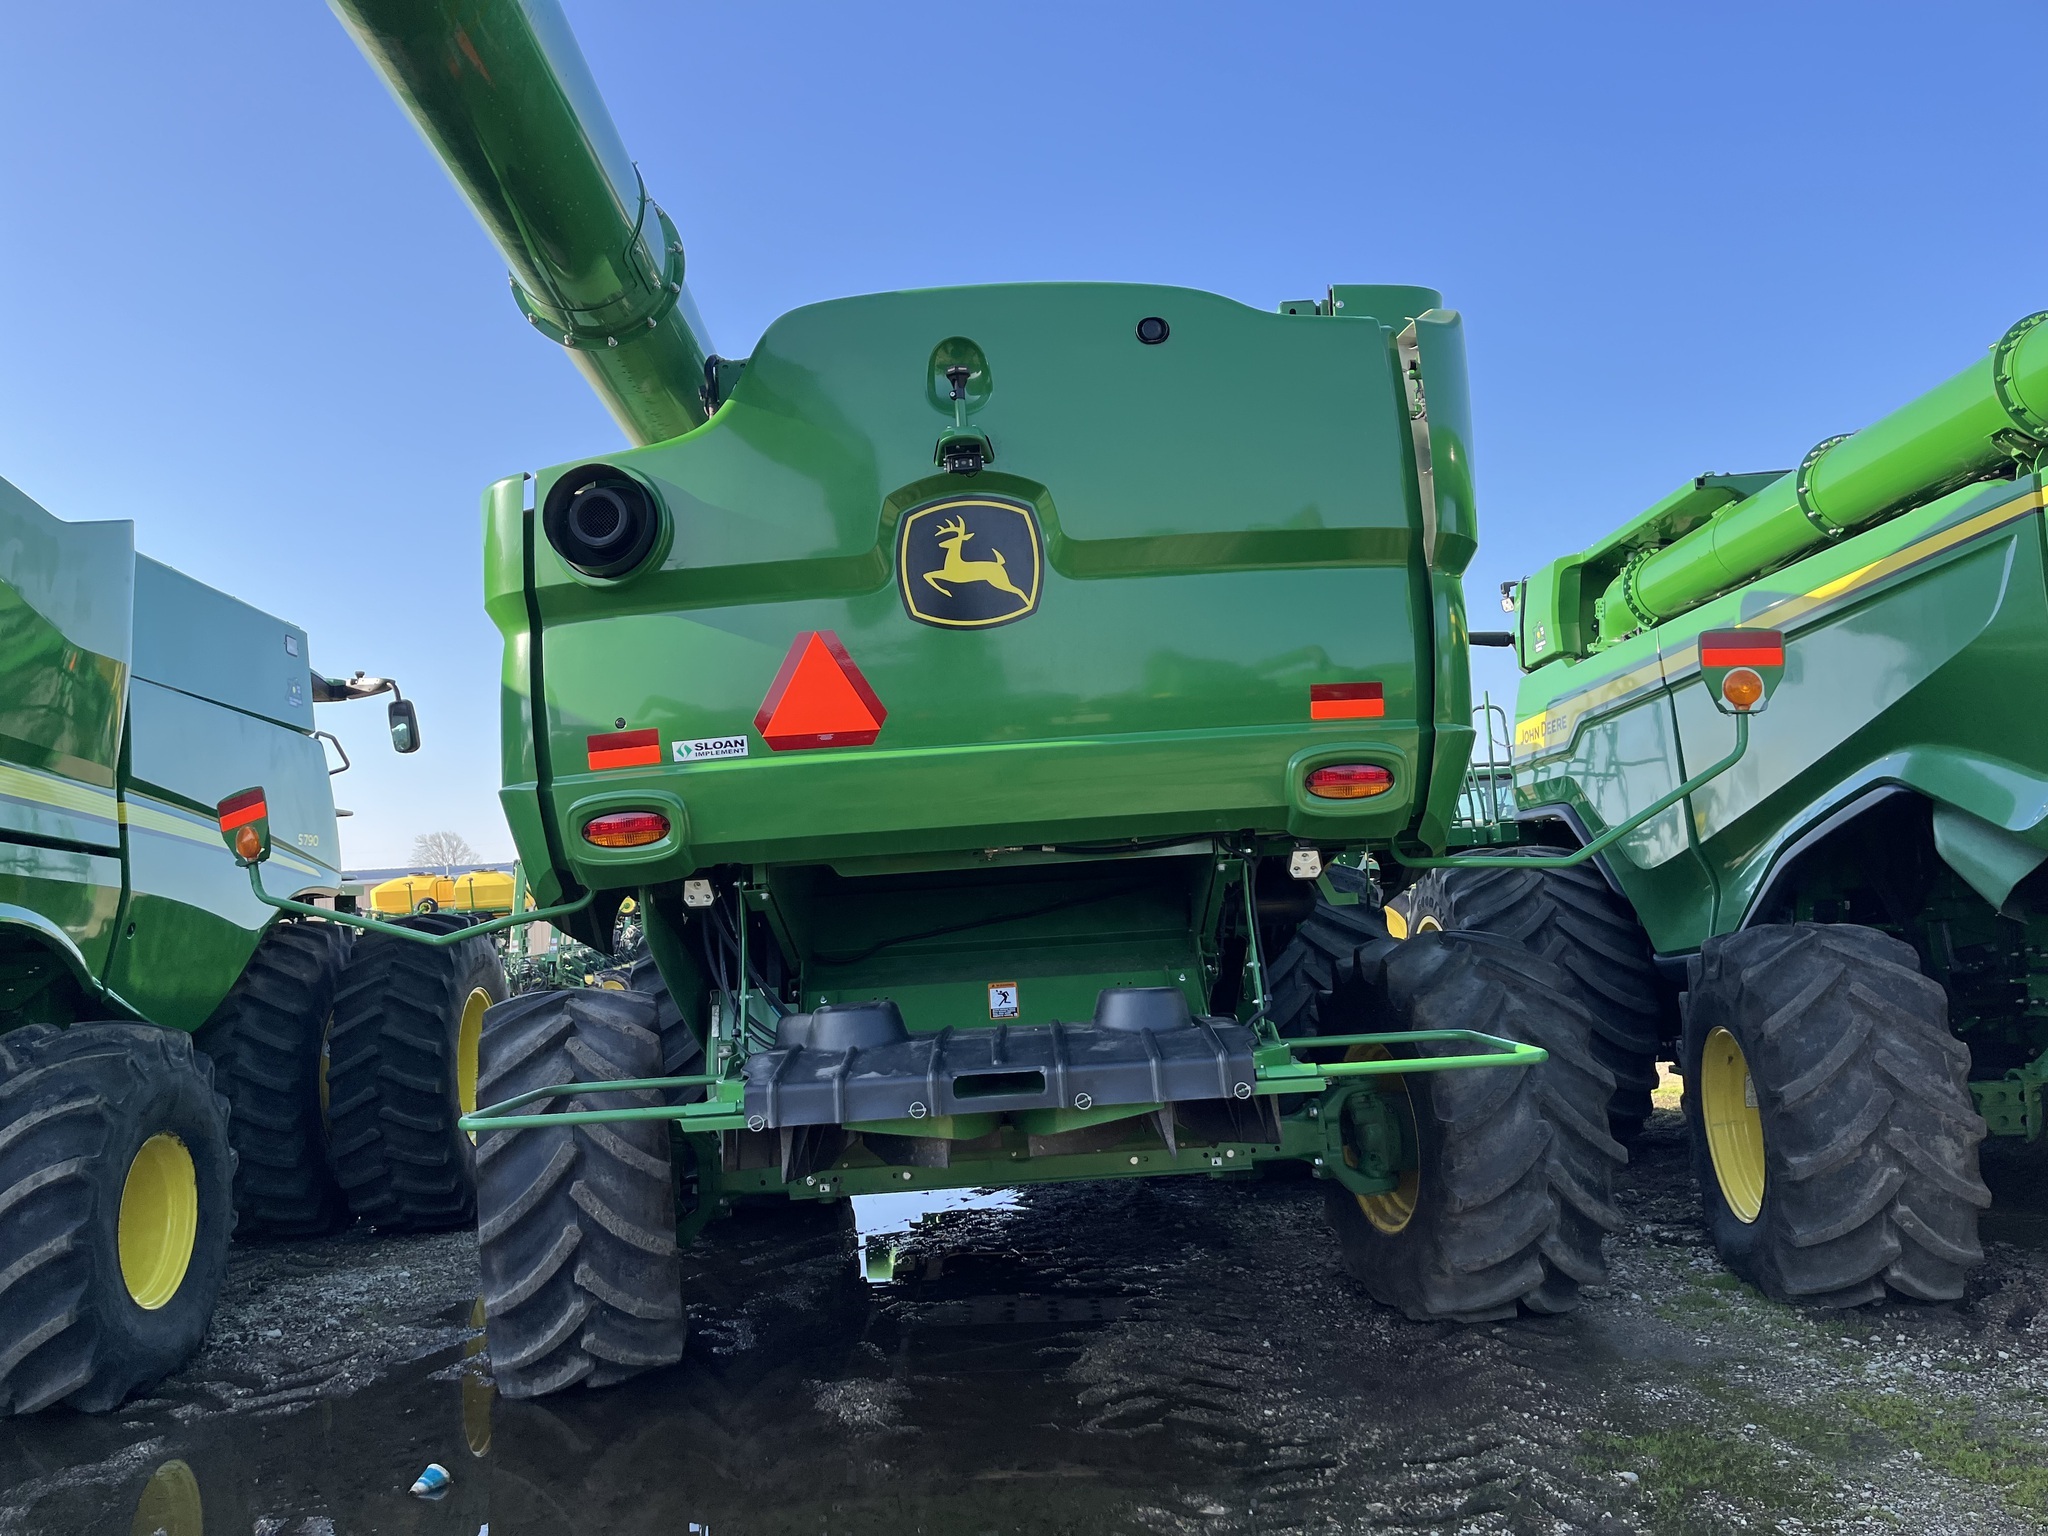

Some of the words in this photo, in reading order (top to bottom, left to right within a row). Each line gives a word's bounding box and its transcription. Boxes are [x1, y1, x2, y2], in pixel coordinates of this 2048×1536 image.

[1521, 726, 1540, 745] JOHN
[1541, 715, 1567, 737] DEERE
[694, 739, 745, 751] SLOAN
[695, 748, 745, 757] IMPLEMENT
[298, 833, 319, 847] S790
